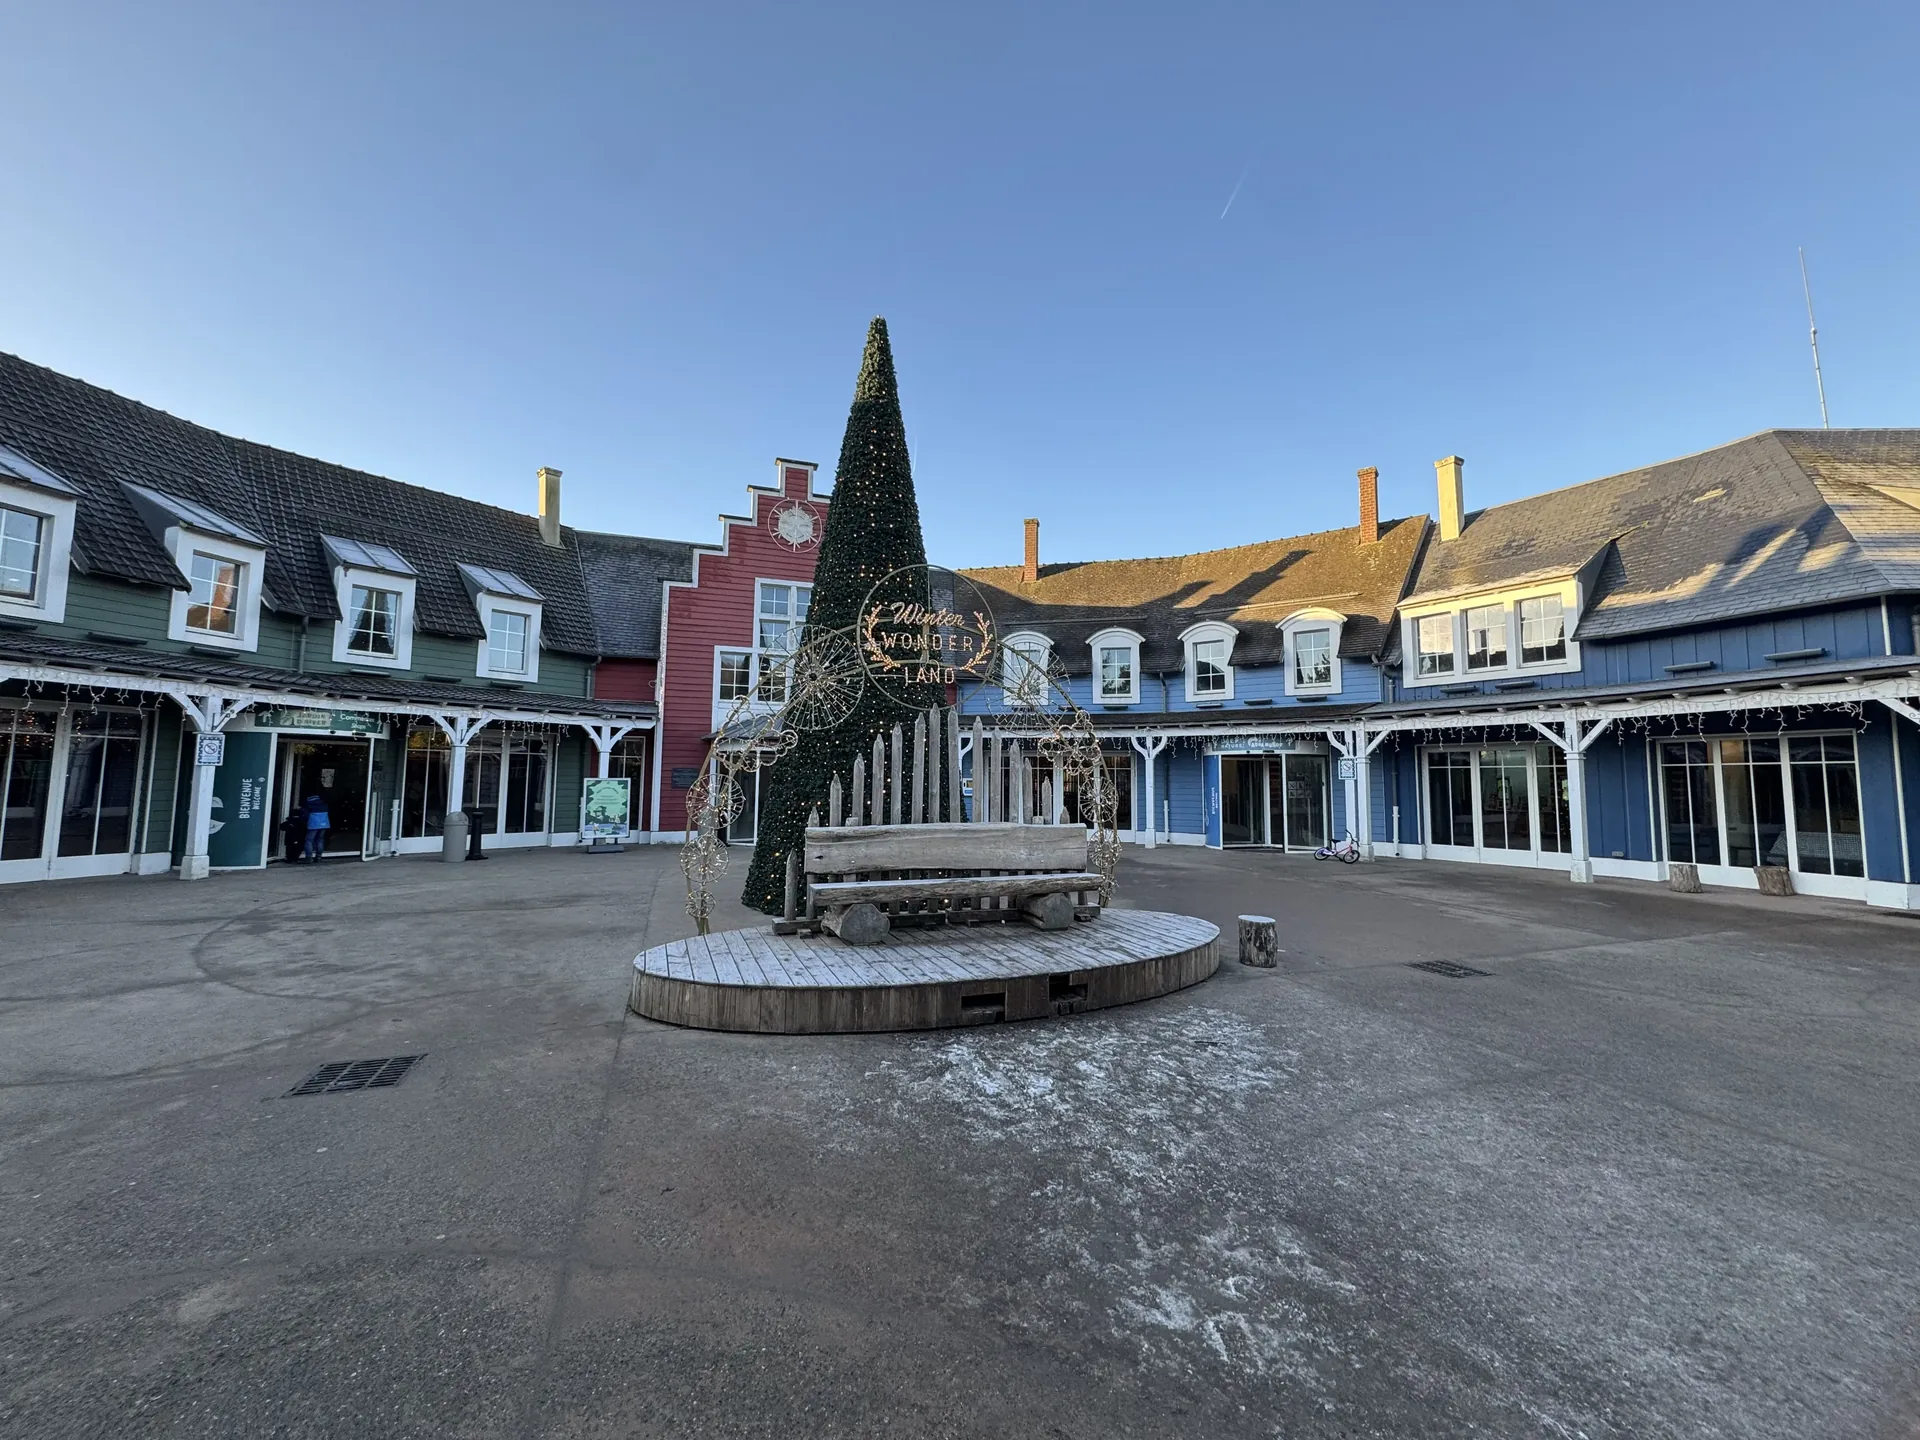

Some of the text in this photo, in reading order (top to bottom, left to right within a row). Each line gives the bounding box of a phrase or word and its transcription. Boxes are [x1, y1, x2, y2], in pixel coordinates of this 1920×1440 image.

[891, 602, 965, 626] Winter
[881, 632, 973, 652] WONDER
[905, 667, 955, 686] LAND
[239, 778, 253, 819] BIENVENUE
[251, 786, 262, 810] WELCOME
